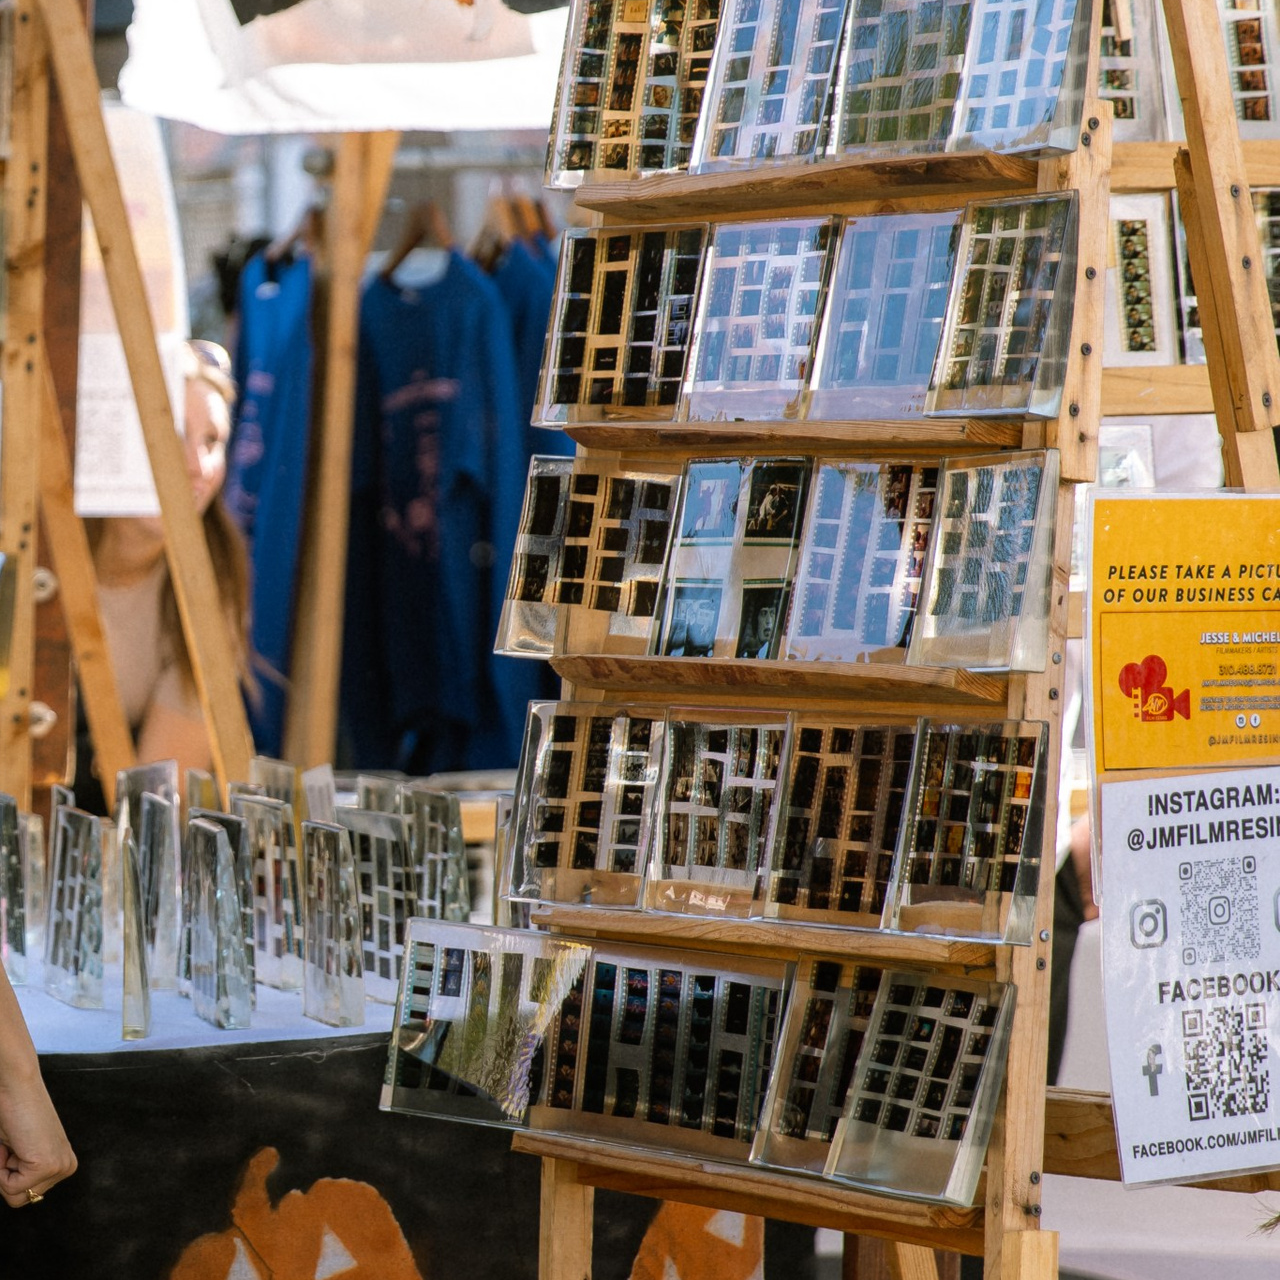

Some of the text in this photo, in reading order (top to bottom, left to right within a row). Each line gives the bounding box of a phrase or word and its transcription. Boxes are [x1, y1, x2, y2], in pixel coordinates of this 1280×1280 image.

[1108, 564, 1169, 580] PLEASE
[1176, 564, 1216, 579] TAKE
[1221, 564, 1232, 579] A
[1103, 588, 1126, 603] OF
[1132, 587, 1169, 603] OUR
[1175, 587, 1256, 603] BUSINESS
[1200, 632, 1230, 644] JESSE
[1232, 632, 1241, 644] &
[1216, 646, 1252, 654] FILMMAKERS
[1148, 783, 1280, 817] INSTAGRAM:
